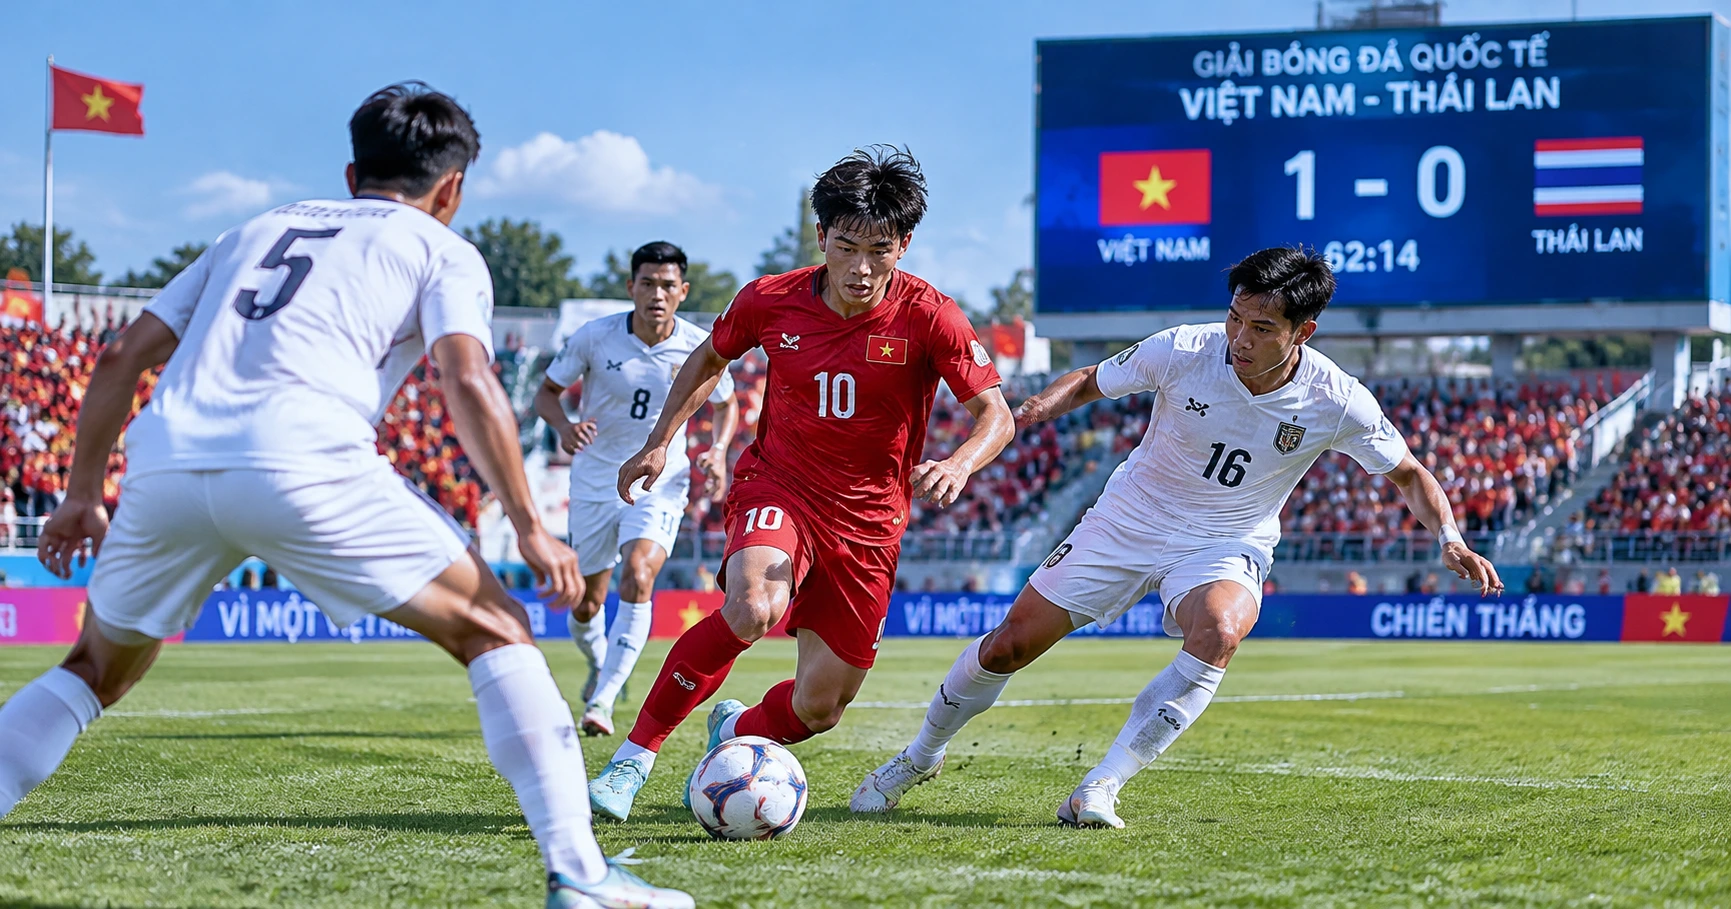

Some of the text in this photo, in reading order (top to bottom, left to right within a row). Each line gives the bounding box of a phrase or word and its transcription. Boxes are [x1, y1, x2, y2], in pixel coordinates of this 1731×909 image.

[1193, 41, 1254, 78] GIẢI
[1410, 32, 1502, 73] QUỐC
[1508, 30, 1550, 68] TẾ
[1178, 72, 1560, 126] VIỆT NAM - THÁI LAN
[1284, 145, 1466, 220] 1 - 0
[1097, 233, 1210, 267] VIỆT NAM
[1324, 239, 1420, 273] 62:14
[1531, 223, 1643, 254] THÁI LAN
[232, 227, 344, 320] 5
[630, 388, 651, 420] 8
[814, 371, 856, 419] 10
[1202, 441, 1252, 487] 16
[743, 506, 784, 536] 10
[218, 592, 249, 638] VÌ
[256, 592, 320, 643] MỘT
[903, 595, 932, 634] VÌ
[1371, 593, 1586, 638] CHIẾN THẮNG
